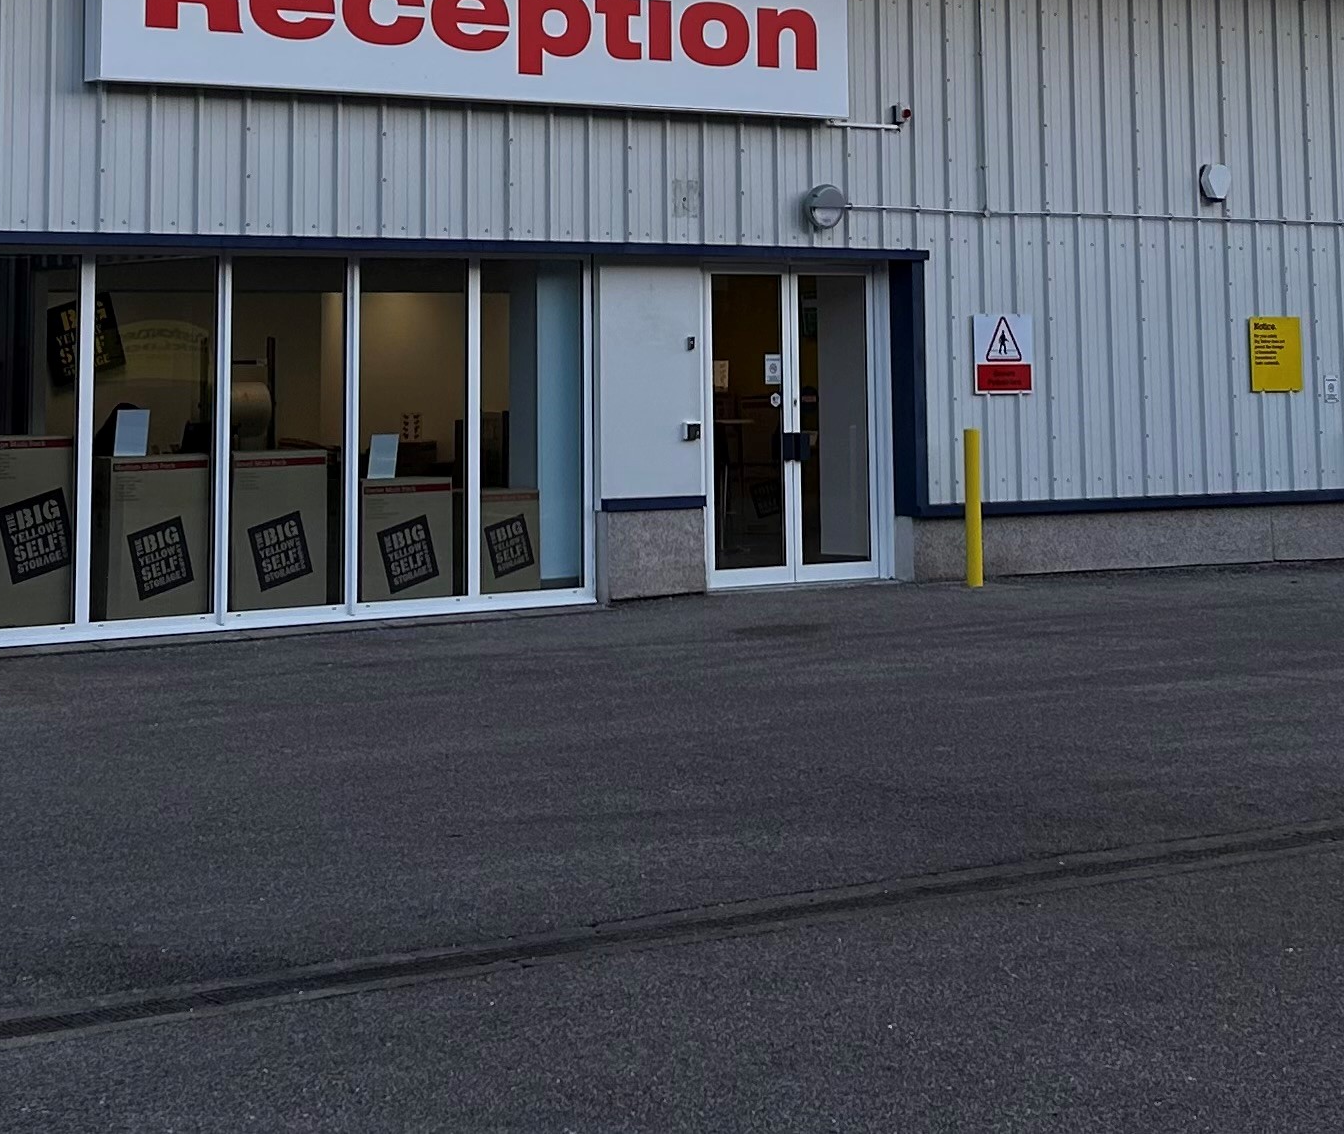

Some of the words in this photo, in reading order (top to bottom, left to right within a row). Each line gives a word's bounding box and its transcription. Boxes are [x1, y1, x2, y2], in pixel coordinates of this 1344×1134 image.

[60, 300, 108, 331] BG
[15, 498, 61, 531] BIG
[10, 520, 57, 546] YELLOW
[142, 526, 180, 554] BIG
[263, 519, 299, 547] BIG
[392, 524, 426, 549] BIG
[496, 520, 524, 543] BIG
[13, 532, 58, 562] SELF
[138, 545, 176, 567] YELLOW
[259, 539, 296, 559] YELLOW
[17, 549, 63, 574] STORAGE
[141, 555, 178, 581] SELF
[262, 548, 298, 573] SELF
[390, 551, 424, 576] SELF
